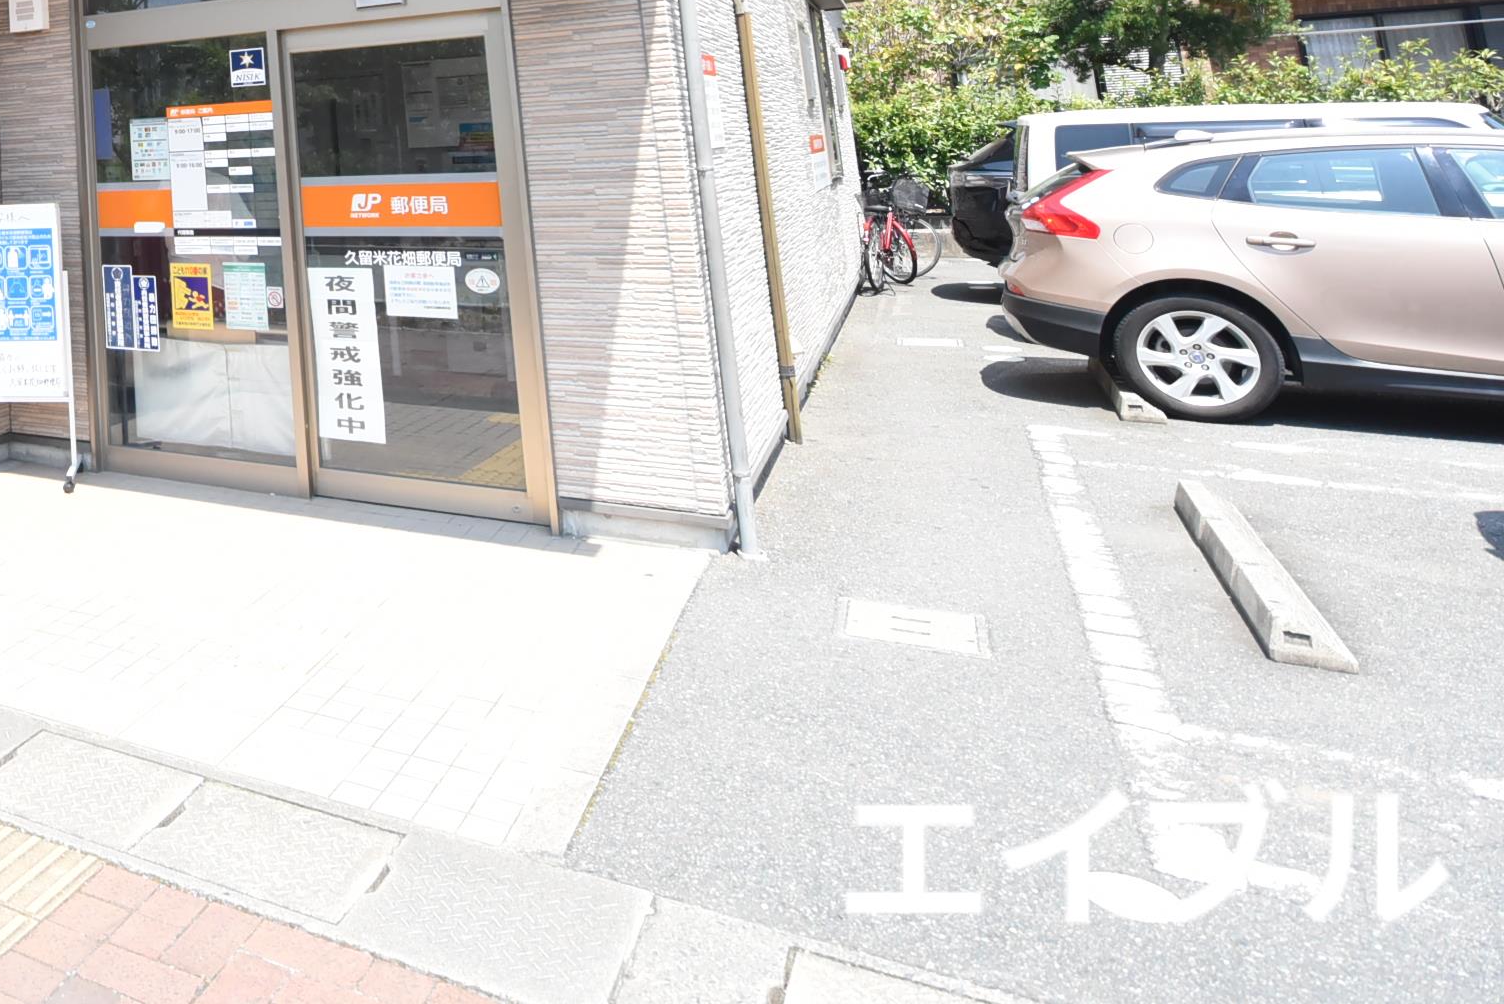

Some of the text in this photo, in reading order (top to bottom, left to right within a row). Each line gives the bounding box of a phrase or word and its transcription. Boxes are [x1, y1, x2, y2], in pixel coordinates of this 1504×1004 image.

[391, 196, 449, 215] 郵便局
[344, 250, 462, 267] 久留米花畑郵便局
[324, 275, 366, 435] 夜間警戒強化中
